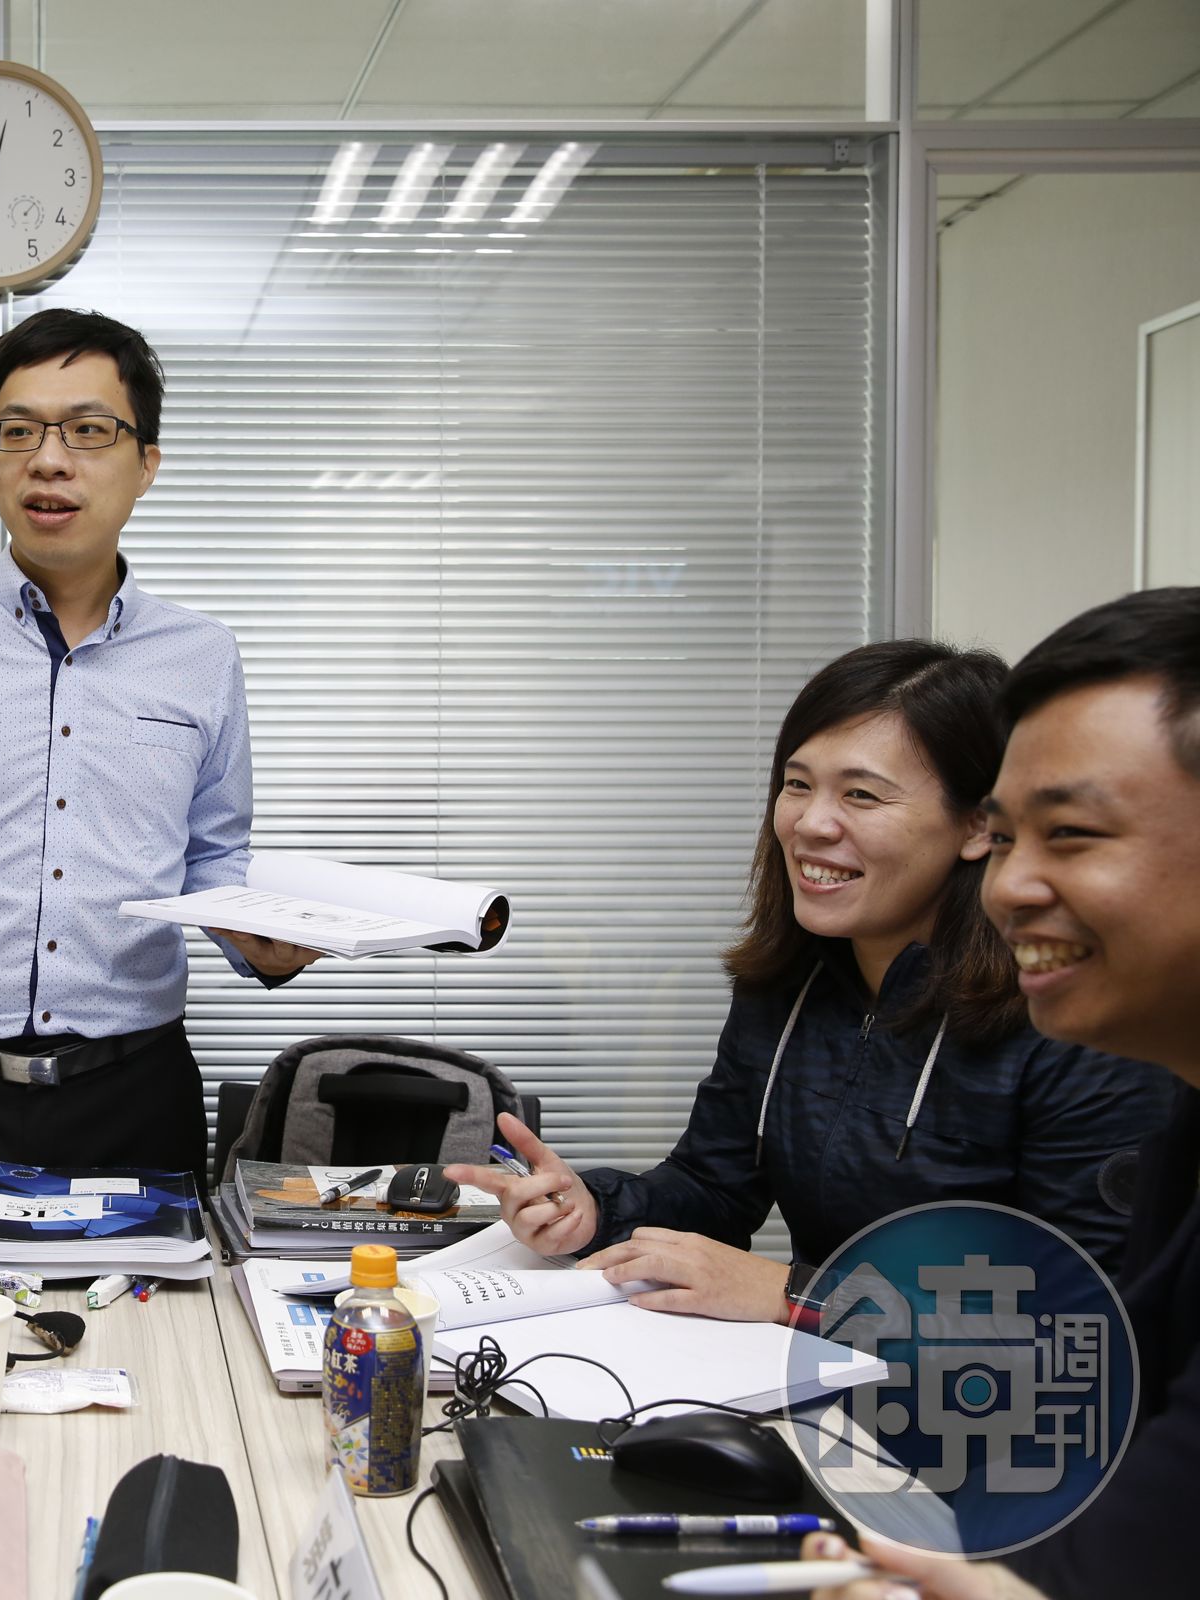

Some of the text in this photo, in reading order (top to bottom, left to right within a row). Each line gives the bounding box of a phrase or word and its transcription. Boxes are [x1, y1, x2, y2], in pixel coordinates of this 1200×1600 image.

[26, 101, 31, 117] 1
[53, 130, 63, 147] 2
[65, 169, 75, 186] 3
[55, 208, 66, 225] 4
[28, 239, 38, 257] 5
[4, 1208, 78, 1218] VIC
